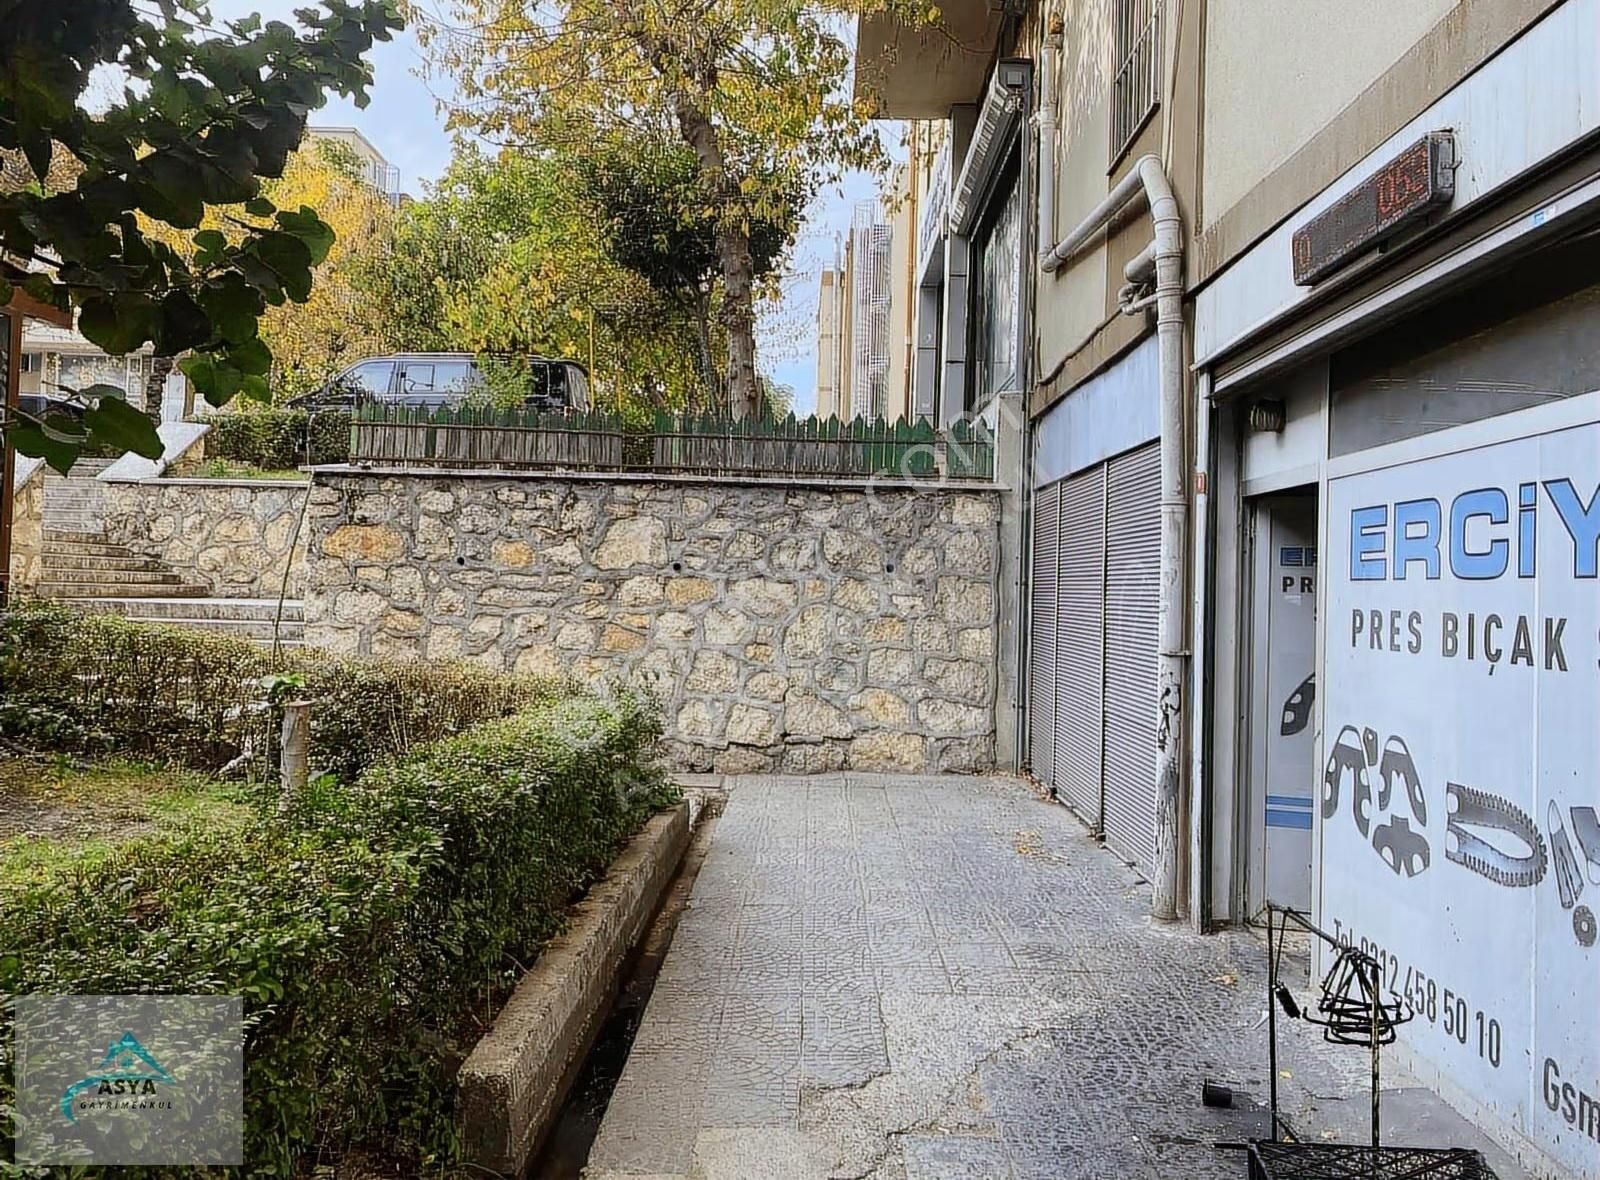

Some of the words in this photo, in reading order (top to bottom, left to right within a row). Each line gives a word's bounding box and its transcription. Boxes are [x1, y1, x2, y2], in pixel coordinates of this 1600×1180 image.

[1352, 608, 1423, 655] PRES
[1442, 611, 1569, 676] BIÇAK
[1404, 965, 1437, 1023] 458
[1443, 987, 1468, 1045] 50
[1476, 1010, 1501, 1069] 10
